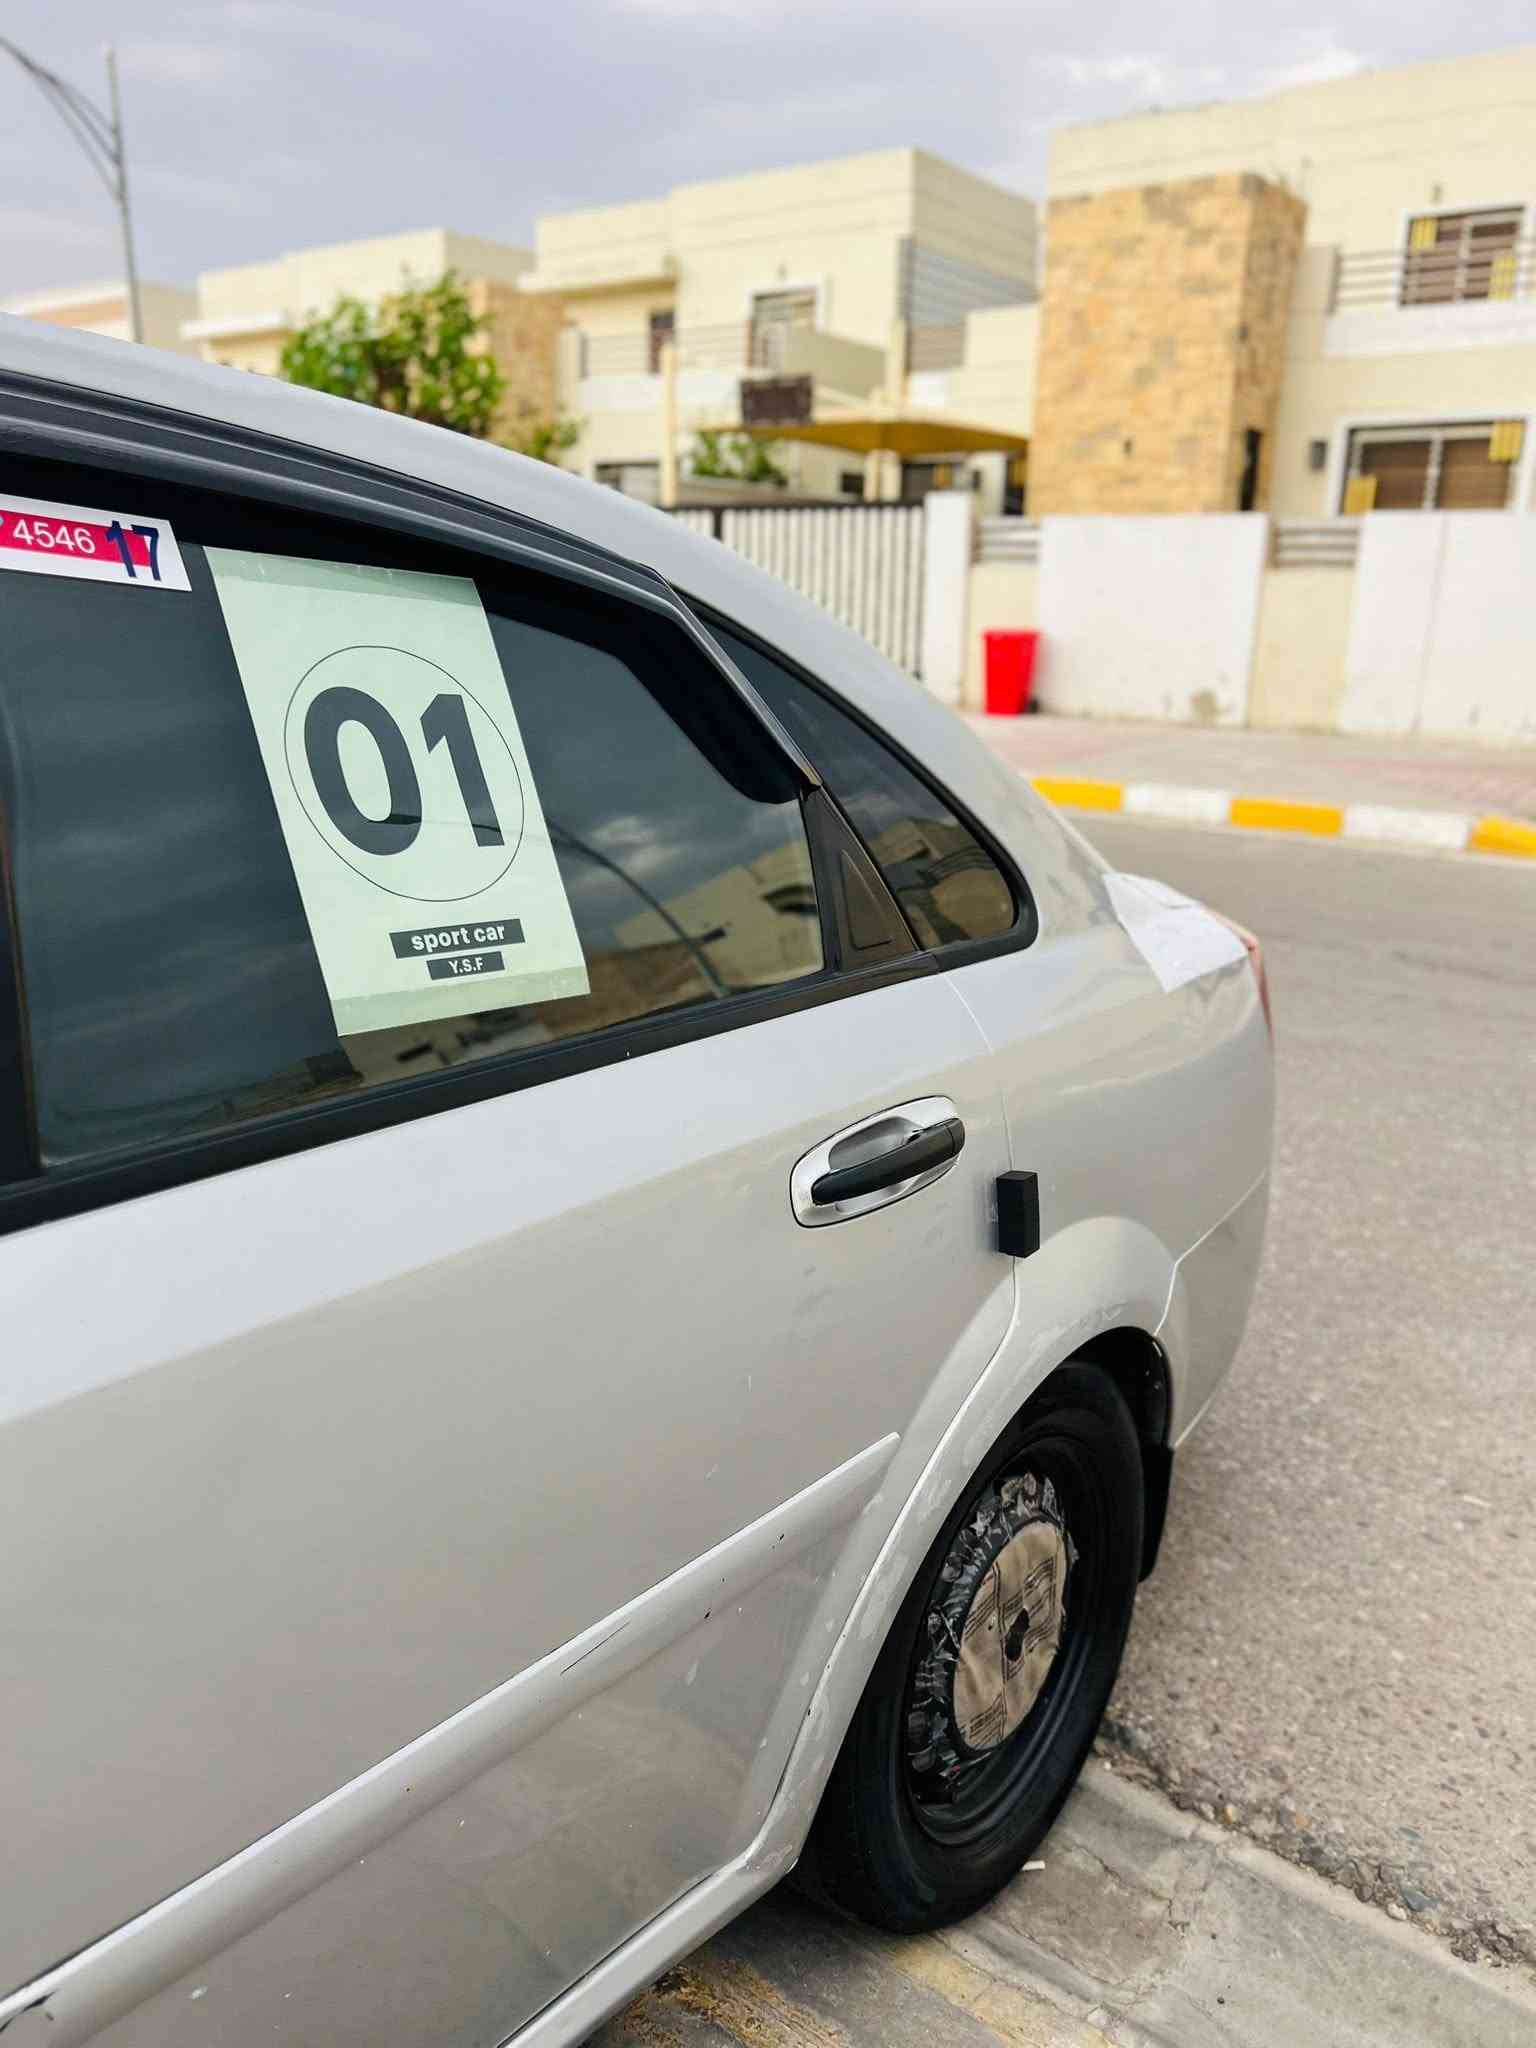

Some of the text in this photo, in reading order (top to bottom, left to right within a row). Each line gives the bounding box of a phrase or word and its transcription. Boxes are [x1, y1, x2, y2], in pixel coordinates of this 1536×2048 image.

[12, 519, 96, 554] 4546
[106, 520, 162, 582] 17
[304, 686, 505, 856] 01
[411, 925, 505, 952] sport car
[448, 956, 484, 975] Y.S.F
